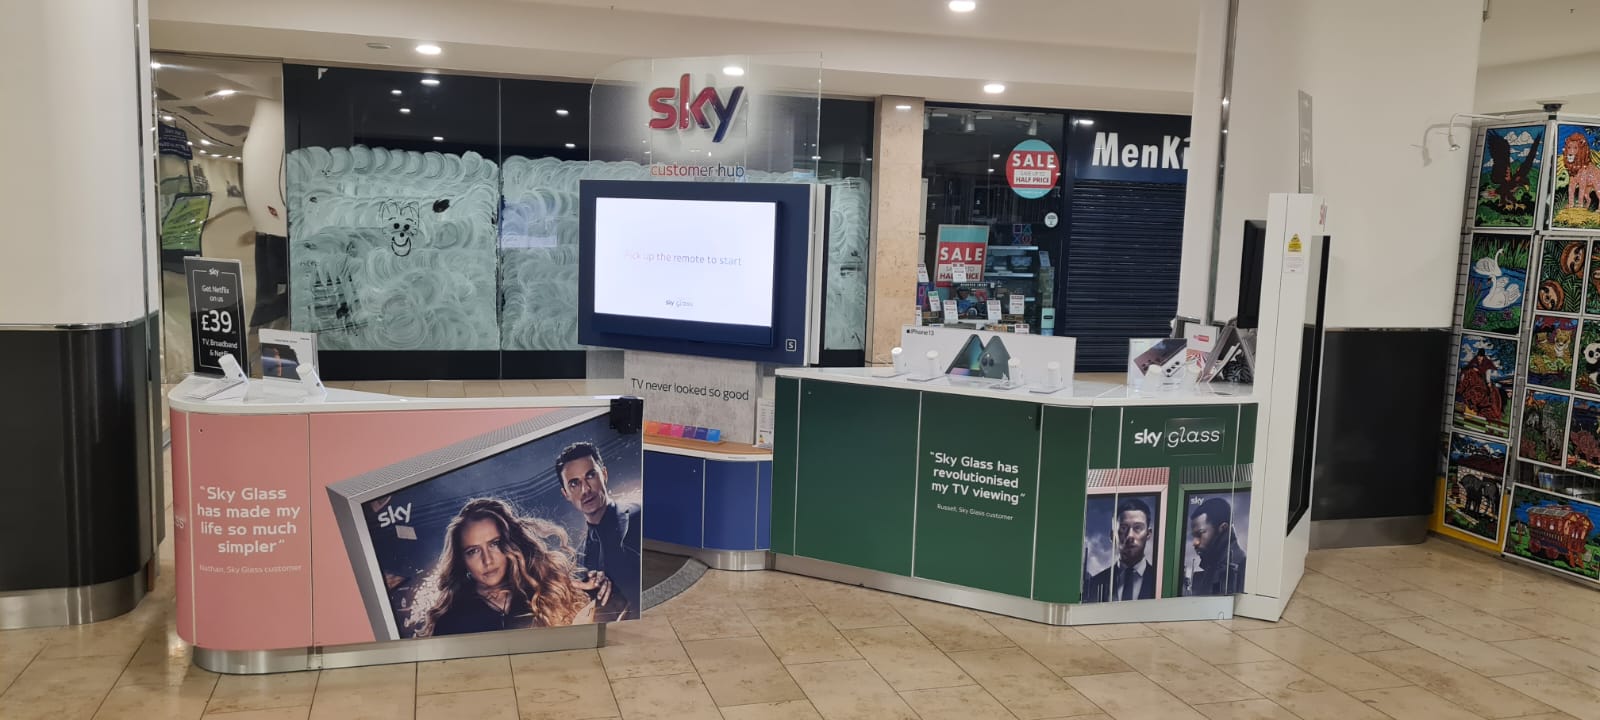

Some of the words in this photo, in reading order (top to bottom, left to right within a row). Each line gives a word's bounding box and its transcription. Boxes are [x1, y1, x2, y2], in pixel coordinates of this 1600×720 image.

[648, 73, 744, 143] sky
[1012, 153, 1056, 168] SALE
[651, 164, 714, 177] customer
[717, 163, 745, 177] hub
[657, 252, 672, 263] the
[673, 253, 705, 264] remote
[707, 255, 717, 265] to
[719, 256, 742, 266] start
[940, 247, 983, 261] SALE
[201, 285, 212, 293] Get
[212, 286, 230, 294] Netflix
[201, 309, 232, 333] £39
[631, 378, 644, 388] TV
[645, 382, 672, 392] never
[674, 383, 707, 396] looked
[708, 388, 721, 398] so
[723, 389, 749, 401] good
[1134, 428, 1162, 447] sky
[1167, 426, 1220, 448] glass
[960, 456, 993, 470] Glass
[997, 460, 1019, 474] has
[933, 468, 1019, 489] revolutionised
[241, 487, 287, 500] Glass
[931, 482, 949, 494] my
[952, 483, 969, 495] TV
[1190, 496, 1204, 506] sky
[197, 503, 221, 518] has
[226, 505, 270, 518] made
[276, 506, 300, 519] my
[377, 502, 412, 528] sky
[958, 506, 969, 514] Sky
[969, 508, 985, 517] Glass
[985, 511, 1013, 521] customer
[201, 521, 223, 535] life
[227, 525, 247, 536] so
[252, 521, 297, 535] much
[226, 566, 240, 574] Sky
[264, 565, 302, 573] customer
